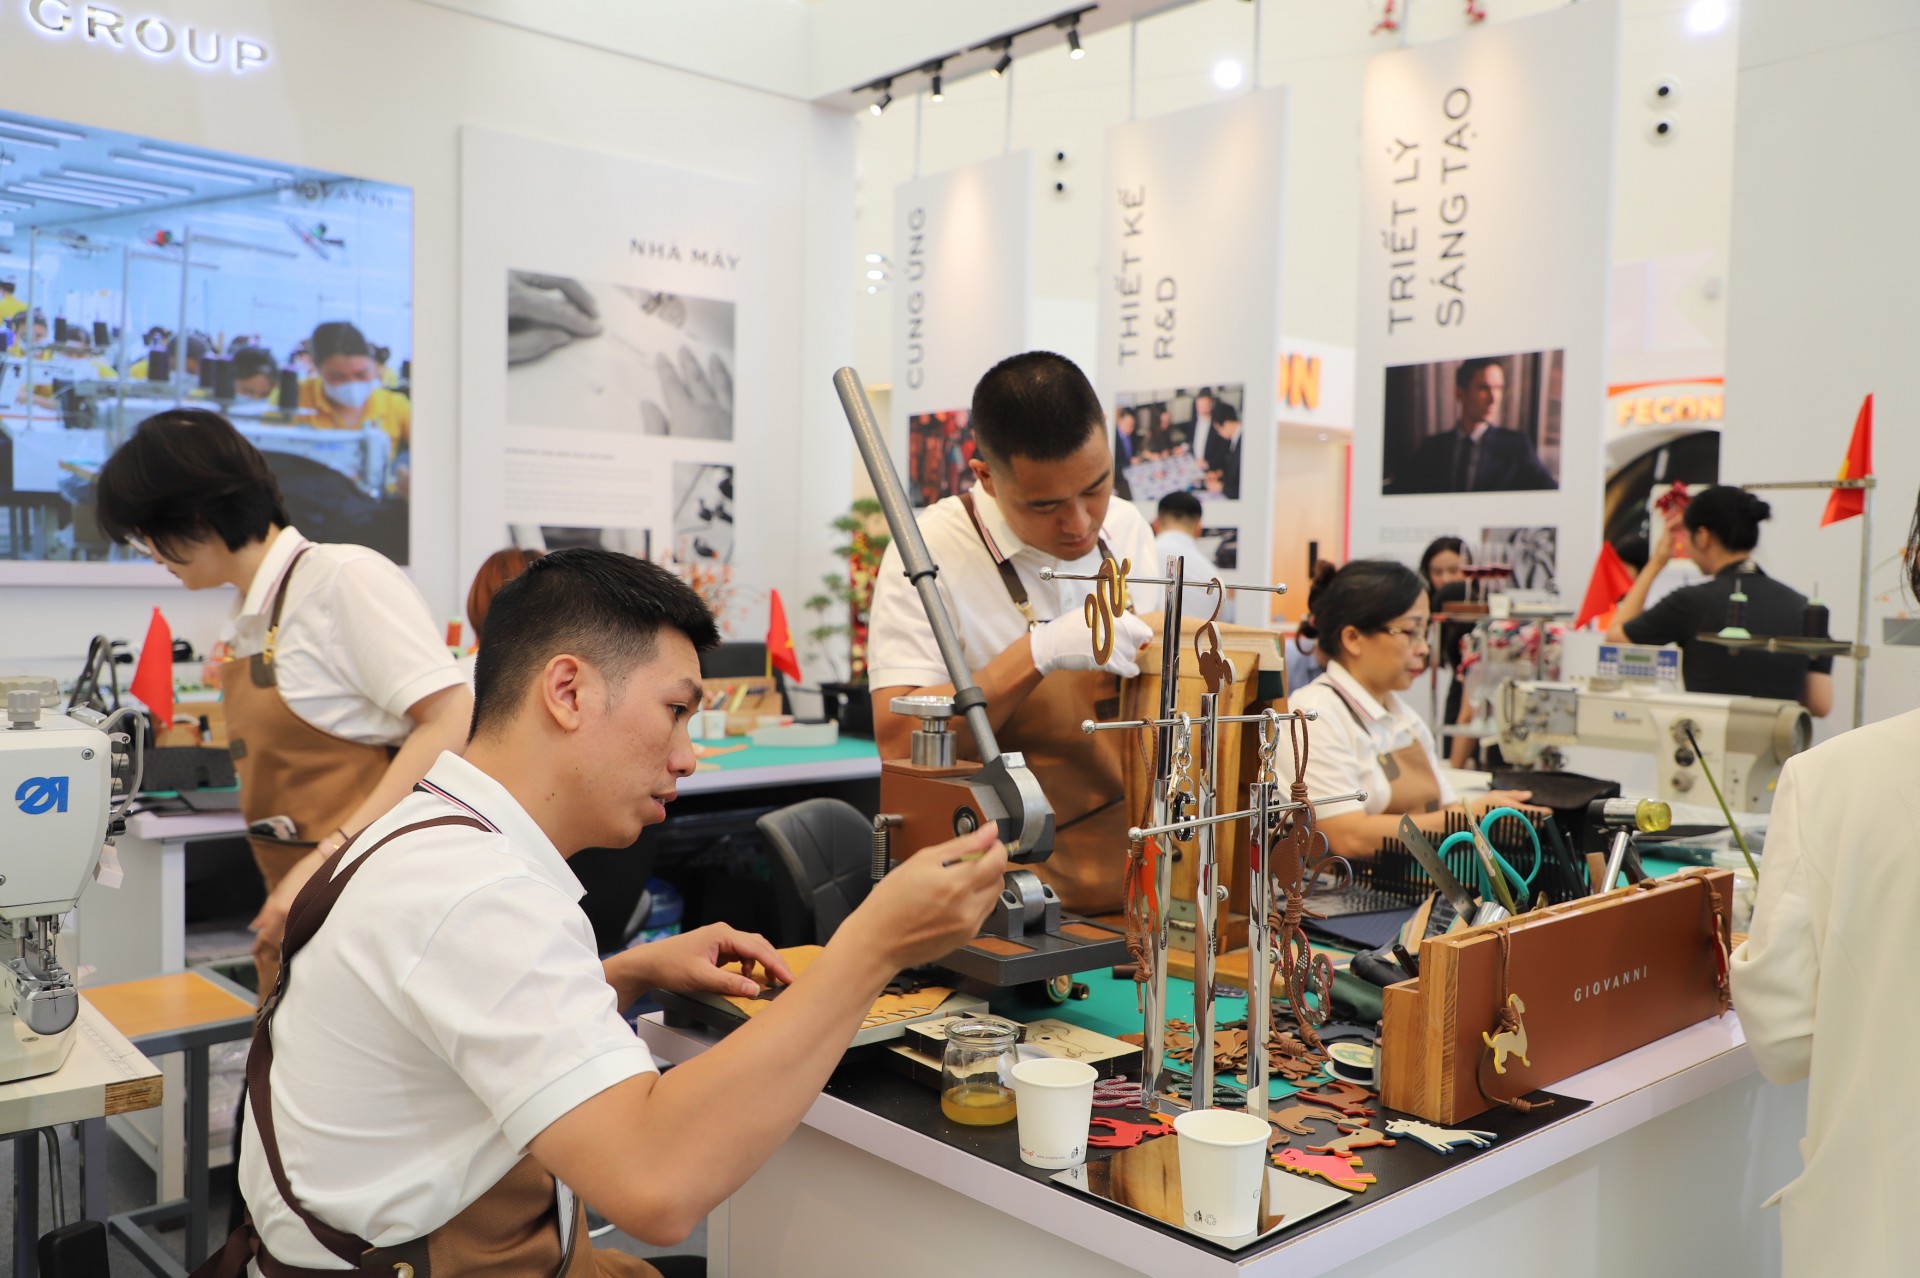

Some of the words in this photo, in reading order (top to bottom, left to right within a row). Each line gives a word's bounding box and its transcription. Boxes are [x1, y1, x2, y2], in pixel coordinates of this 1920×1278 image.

[28, 0, 270, 70] GROUP
[1442, 86, 1478, 185] TẠO
[1381, 200, 1418, 335] TRIẾT
[1430, 194, 1468, 327] SÁNG
[906, 291, 926, 390] CUNG
[1153, 276, 1178, 360] R&D
[1574, 964, 1647, 1002] GIOVANNI
